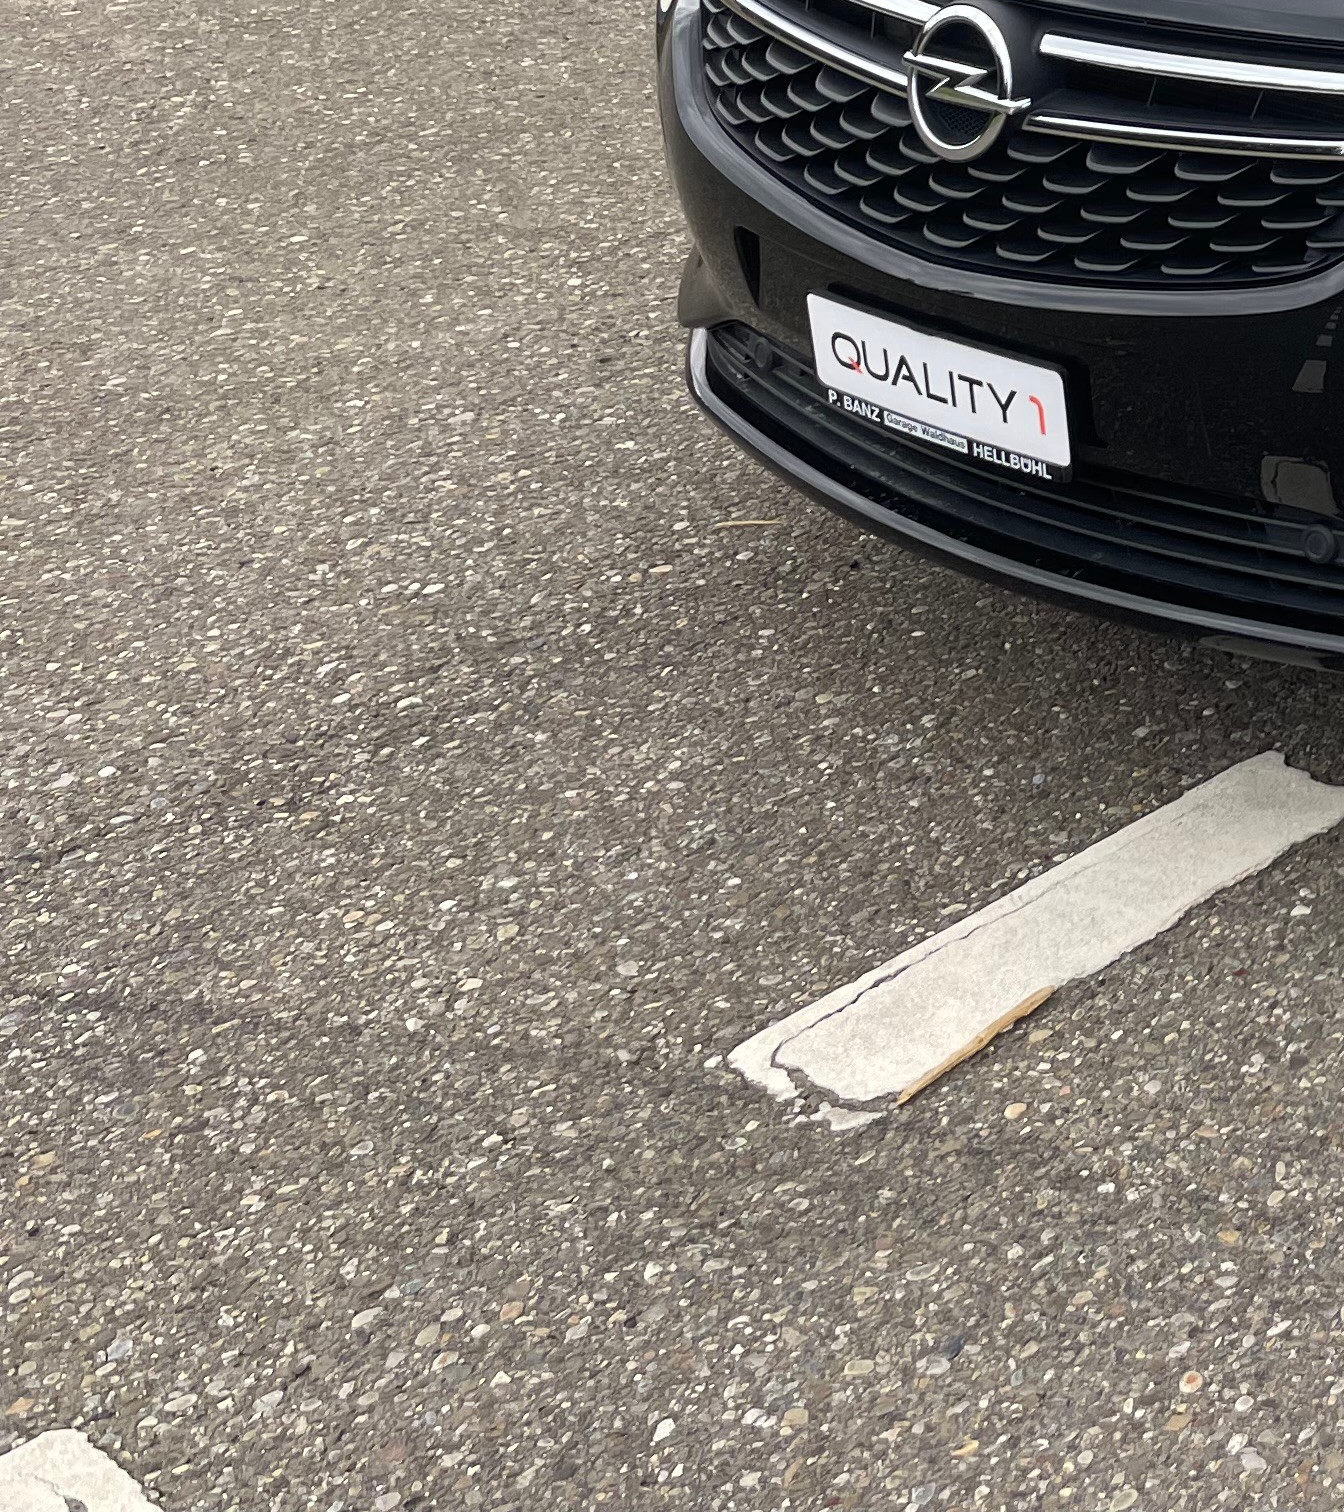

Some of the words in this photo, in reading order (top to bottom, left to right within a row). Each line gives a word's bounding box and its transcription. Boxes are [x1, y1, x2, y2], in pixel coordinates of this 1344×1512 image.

[831, 331, 1017, 424] QUALITY
[828, 389, 841, 407] P.
[843, 395, 881, 422] BANZ
[886, 413, 918, 433] Garage
[920, 425, 966, 449] Waldhaus
[973, 442, 1052, 480] HELLBÜHL
